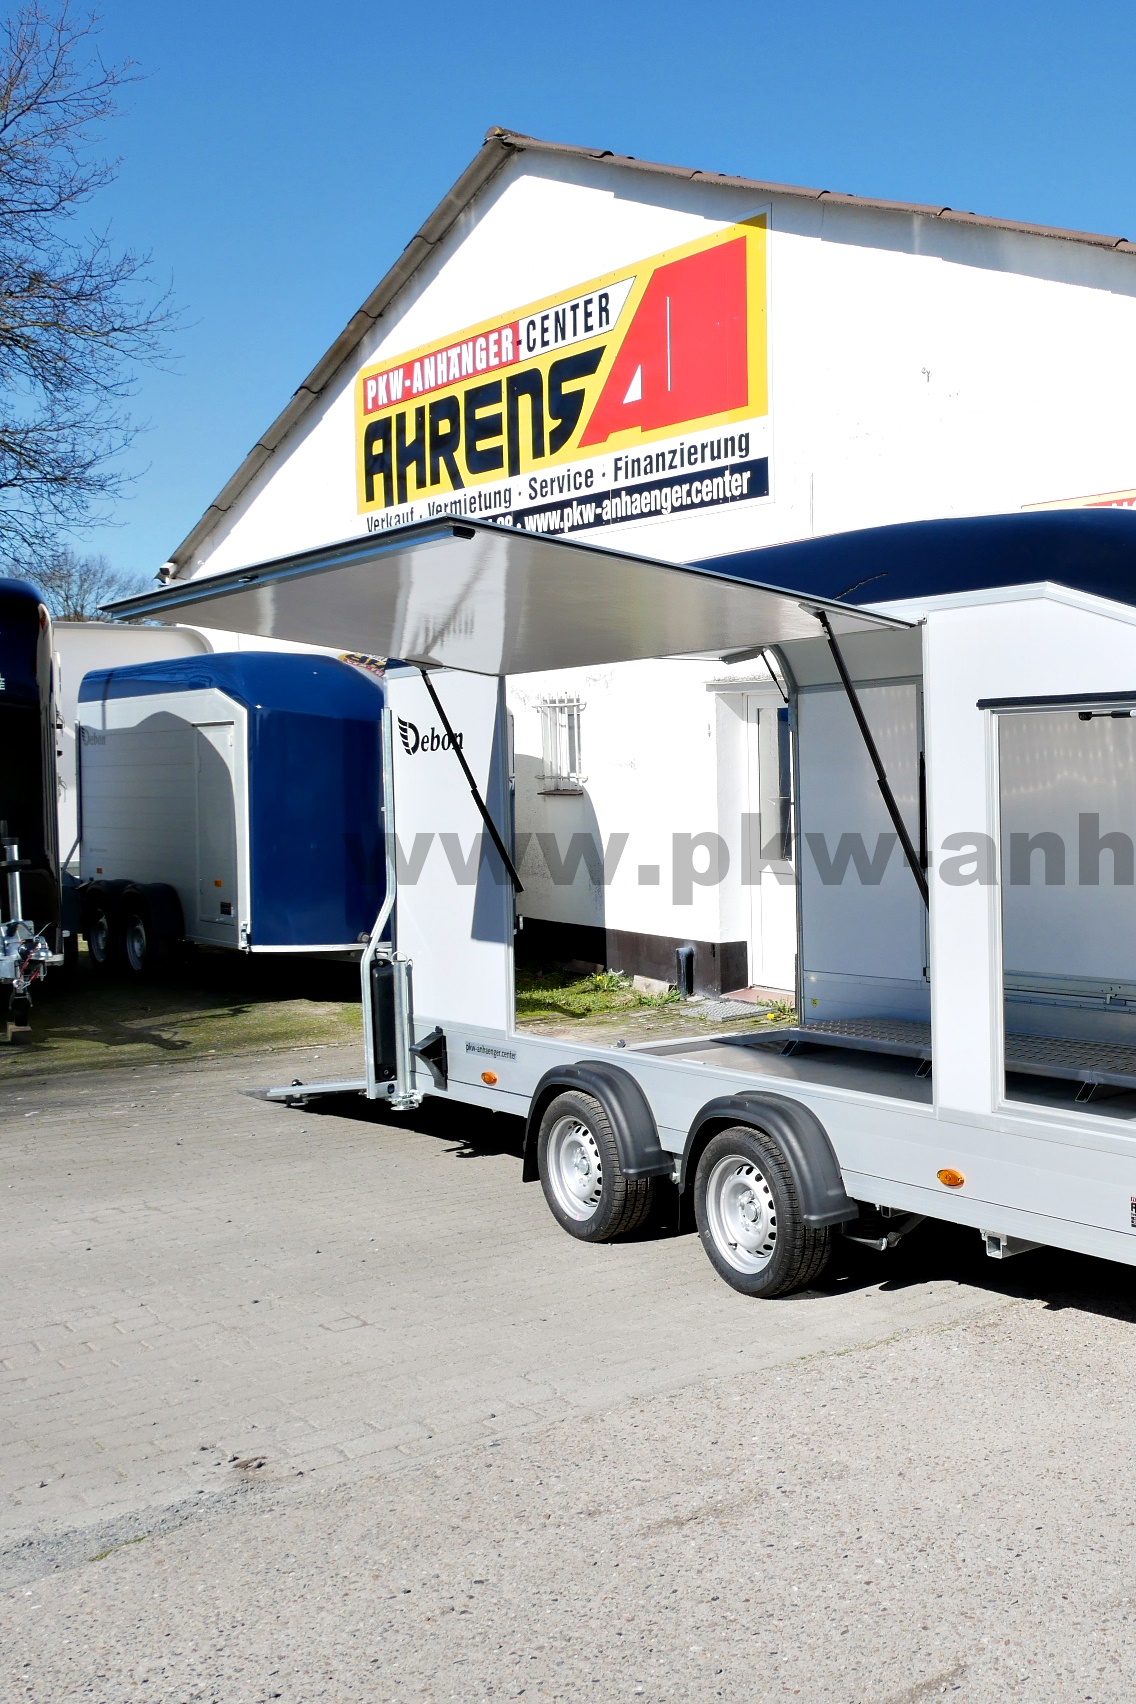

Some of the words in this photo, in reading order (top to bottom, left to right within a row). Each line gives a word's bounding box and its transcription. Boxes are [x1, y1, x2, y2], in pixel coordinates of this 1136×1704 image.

[365, 344, 608, 509] AHRENS
[428, 487, 511, 517] Vermietung
[528, 468, 594, 500] Service
[613, 431, 750, 482] Finanzierung
[524, 469, 751, 533] www.pkw-anhaenger.center
